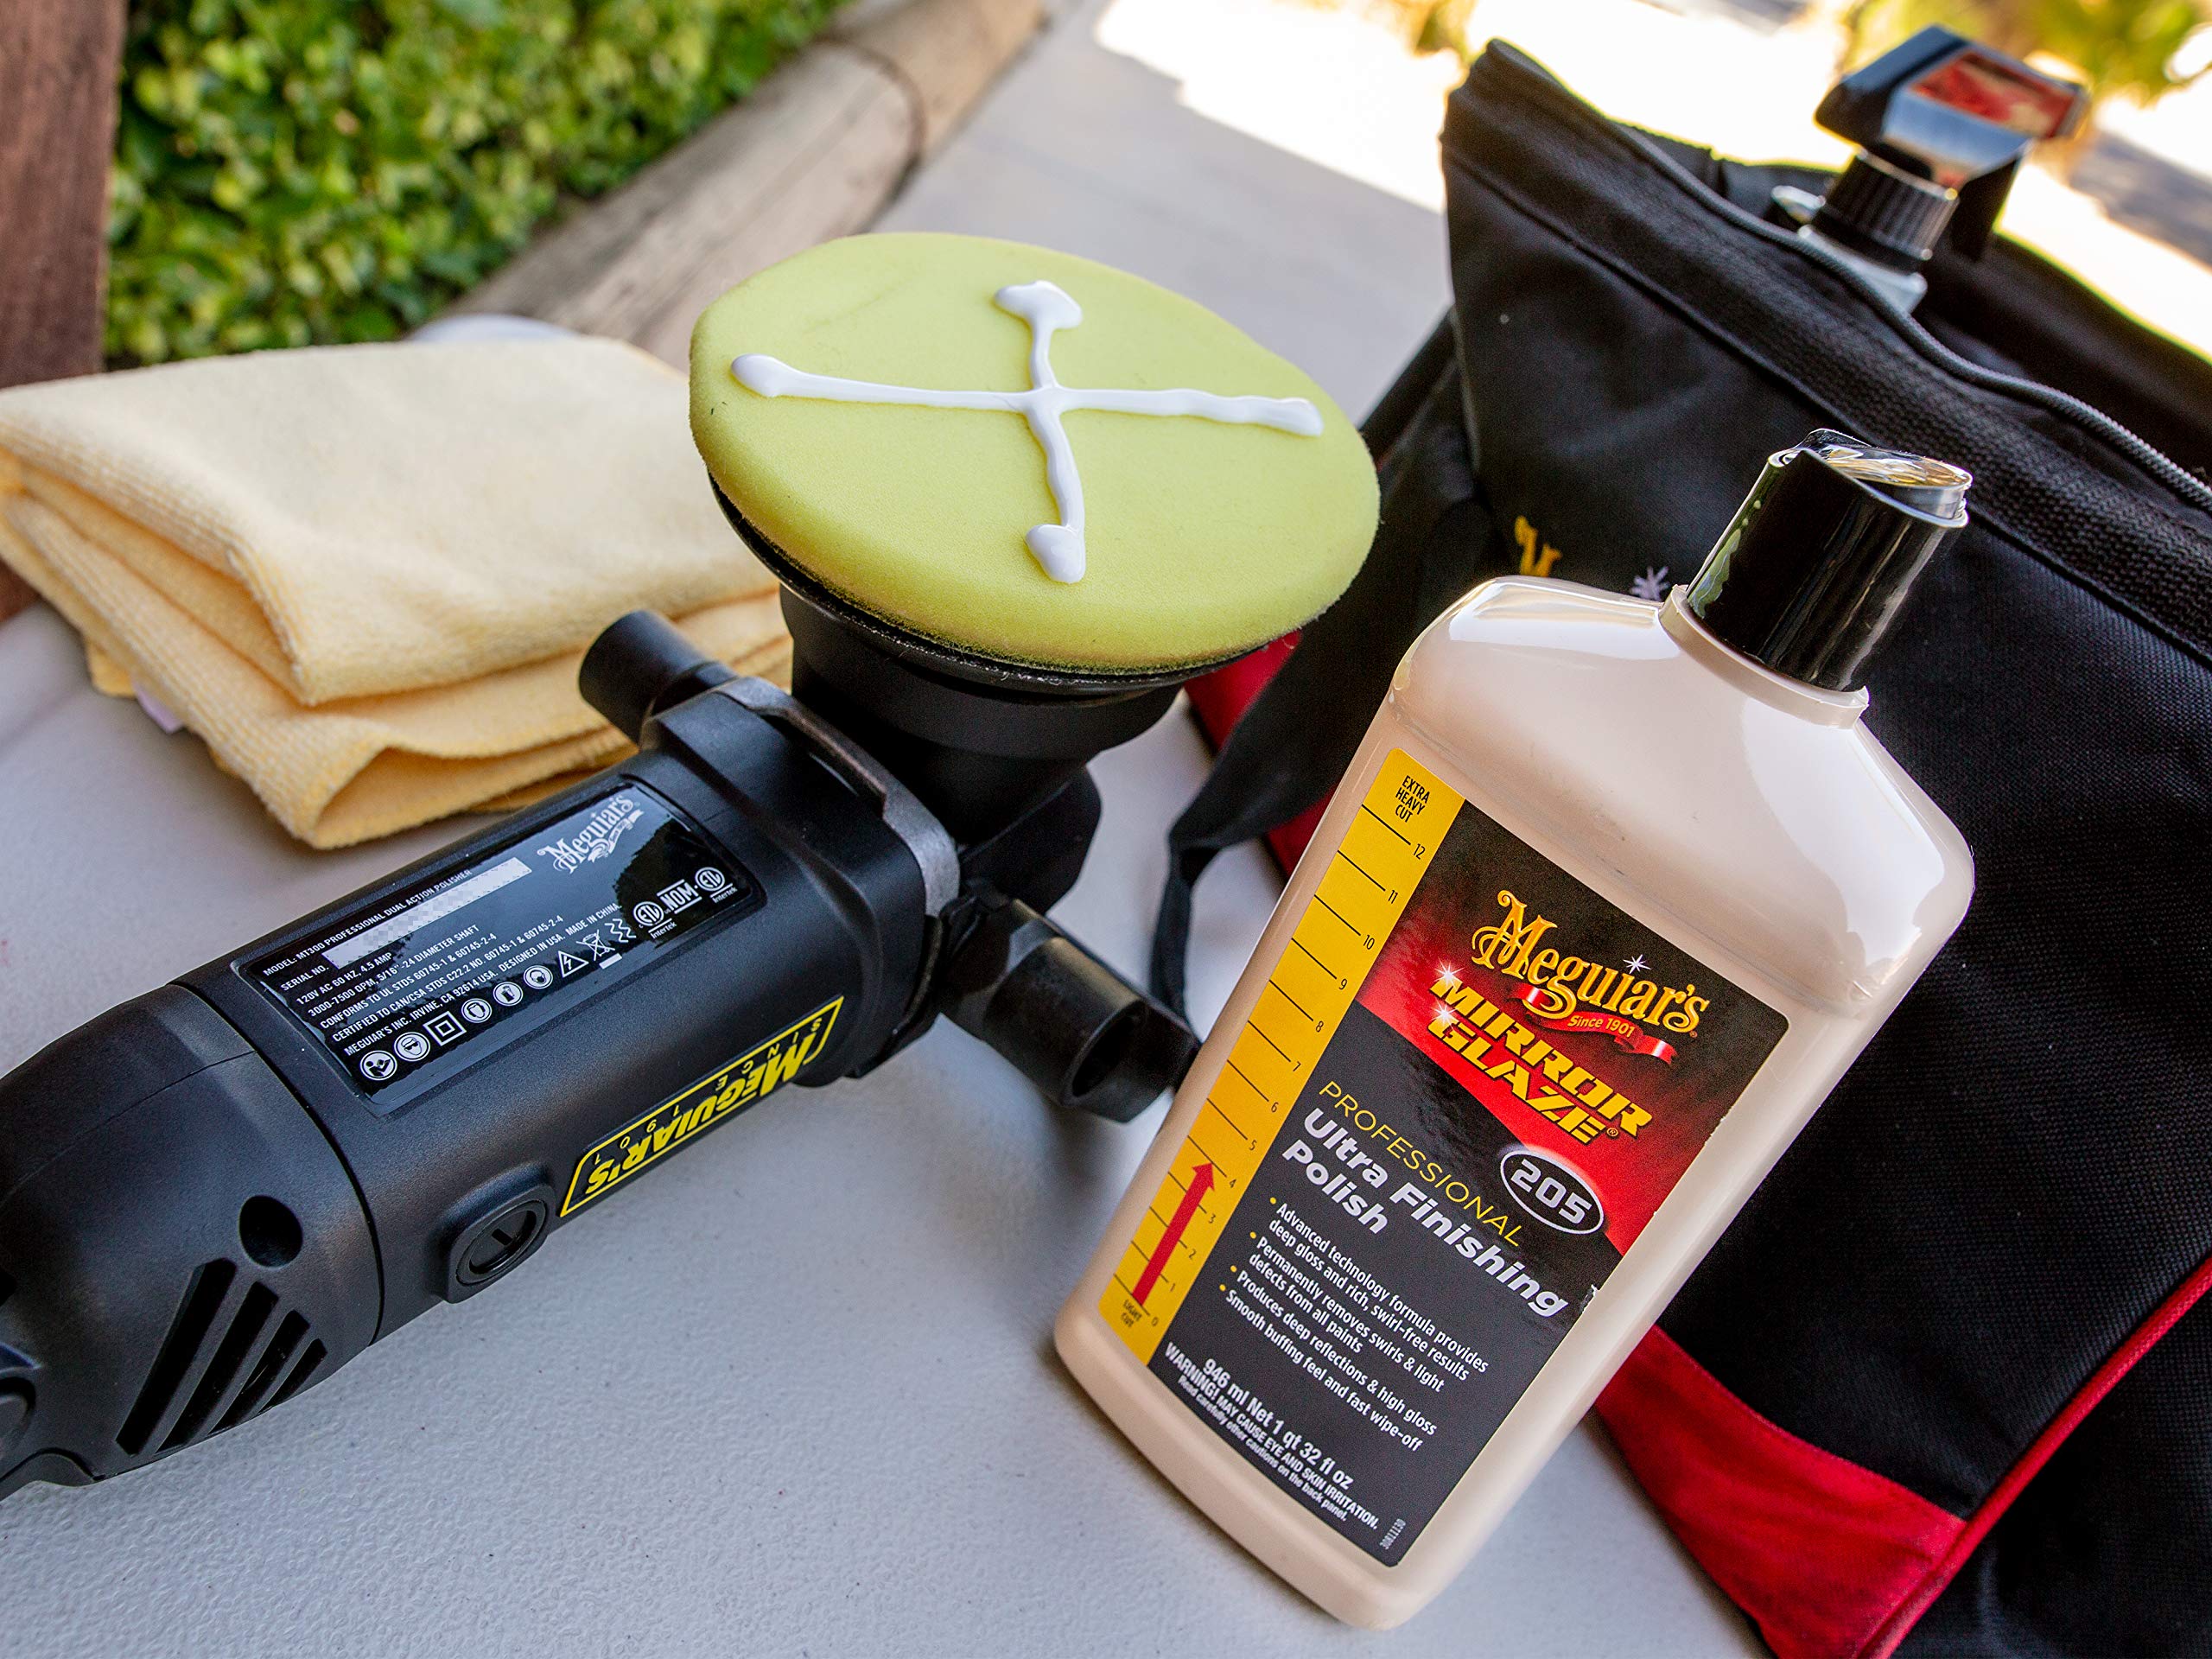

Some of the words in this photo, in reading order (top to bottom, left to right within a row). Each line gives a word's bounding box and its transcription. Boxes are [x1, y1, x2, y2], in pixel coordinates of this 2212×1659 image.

[1395, 786, 1426, 816] HEAVY
[1395, 804, 1414, 823] CUT
[1402, 774, 1431, 804] EXTRA
[537, 795, 634, 874] Meguiar's
[1413, 843, 1426, 861] 12
[263, 957, 298, 976] MODEL:
[296, 942, 326, 960] MT300
[323, 912, 386, 946] PROFESSIONAL
[383, 902, 408, 916] DUAL
[405, 887, 435, 906] ACTION
[433, 869, 474, 893] POLISHER
[660, 882, 699, 912] NOM
[711, 886, 738, 904] Intertek
[1388, 889, 1399, 905] 11
[650, 921, 677, 939] Intertek
[1363, 934, 1376, 950] 10
[1471, 890, 1710, 1033] Meguiar's
[280, 972, 314, 991] SERIAL
[311, 964, 329, 976] NO.
[296, 989, 320, 1005] 120V
[319, 983, 334, 994] AC
[332, 976, 346, 987] 60
[343, 969, 362, 981] HZ,
[360, 961, 375, 972] 4.5
[373, 952, 392, 966] AMP
[308, 988, 356, 1017] 3000-7500
[354, 978, 379, 993] OPM,
[376, 957, 416, 982] 5/16"-24
[413, 937, 456, 963] DIAMETER
[453, 924, 480, 942] SHAFT
[320, 1000, 370, 1029] CONFORMS
[366, 993, 382, 1004] TO
[378, 988, 394, 997] UL
[391, 976, 415, 991] STDS
[413, 958, 448, 980] 60745-1
[447, 954, 457, 963] &
[454, 932, 497, 958] 60745-2-4
[332, 1014, 378, 1042] CERTIFIED
[375, 1007, 391, 1018] TO
[389, 988, 427, 1012] CAN/CSA
[425, 976, 448, 993] STDS
[446, 964, 472, 982] C22.2
[468, 957, 486, 969] NO.
[484, 939, 518, 961] 60745-1
[523, 914, 563, 940] 60745-2-4
[344, 1026, 393, 1056] MEGUIAR'S
[391, 1016, 412, 1031] INC.
[410, 1000, 443, 1020] IRVINE,
[440, 992, 455, 1004] CA
[452, 978, 480, 997] 92614
[477, 969, 499, 983] USA.
[498, 947, 538, 972] DESIGNED
[536, 941, 549, 951] IN
[545, 933, 566, 946] USA.
[565, 919, 588, 936] MADE
[586, 914, 598, 925] IN
[594, 902, 622, 919] CHINA.
[1338, 978, 1348, 990] 9
[716, 1018, 823, 1090] SINCE
[1315, 1020, 1325, 1033] 8
[1429, 974, 1652, 1137] MIRROR
[1567, 1015, 1604, 1028] Since
[1605, 1018, 1635, 1037] 1901
[1293, 1060, 1301, 1072] 7
[585, 1033, 817, 1194] MEGUIAR'S
[594, 1105, 680, 1166] 1901
[1270, 1101, 1279, 1113] 6
[1248, 1139, 1258, 1151] 5
[1319, 1080, 1522, 1247] PROFESSIONAL
[1229, 1179, 1237, 1189] 4
[1281, 1139, 1388, 1234] Polish
[1304, 1107, 1389, 1189] Ultra
[1389, 1181, 1569, 1317] Finishing
[1510, 1158, 1592, 1224] 205
[1208, 1213, 1217, 1224] 3
[1188, 1248, 1198, 1260] 2
[1170, 1282, 1177, 1293] 1
[1249, 1254, 1287, 1291] defects
[1285, 1284, 1313, 1313] from
[1312, 1308, 1331, 1325] all
[1325, 1320, 1363, 1353] paints
[1256, 1236, 1324, 1300] Permanently
[1321, 1294, 1371, 1338] removes
[1368, 1332, 1405, 1363] swirls
[1402, 1357, 1415, 1372] &
[1414, 1363, 1445, 1393] light
[1268, 1219, 1297, 1248] deep
[1294, 1243, 1325, 1272] gloss
[1323, 1266, 1349, 1289] and
[1344, 1284, 1369, 1312] rich,
[1370, 1305, 1428, 1353] swirl-free
[1427, 1346, 1470, 1381] results
[1275, 1203, 1331, 1253] Advanced
[1327, 1245, 1391, 1302] technology
[1388, 1294, 1436, 1337] formula
[1433, 1331, 1490, 1373] provides
[1152, 1317, 1158, 1326] 0
[1236, 1269, 1284, 1318] Produces
[1282, 1313, 1312, 1340] deep
[1309, 1335, 1369, 1386] reflections
[1366, 1379, 1379, 1395] &
[1376, 1386, 1406, 1414] high
[1402, 1408, 1438, 1436] gloss
[1225, 1289, 1266, 1331] Smooth
[1263, 1323, 1305, 1364] buffing
[1302, 1357, 1328, 1381] feel
[1324, 1376, 1350, 1399] and
[1346, 1391, 1371, 1416] fast
[1370, 1410, 1424, 1452] wipe-off
[1165, 1341, 1221, 1401] WARNING!
[1216, 1395, 1240, 1418] MAY
[1236, 1413, 1268, 1443] CAUSE
[1263, 1436, 1285, 1458] EYE
[1281, 1452, 1304, 1472] AND
[1301, 1467, 1327, 1491] SKIN
[1324, 1484, 1379, 1529] IRRITATION.
[1177, 1374, 1199, 1397] Read
[1195, 1393, 1229, 1426] carefully
[1225, 1421, 1248, 1441] other
[1245, 1438, 1280, 1469] cautions
[1277, 1464, 1291, 1478] on
[1287, 1471, 1304, 1488] the
[1301, 1482, 1324, 1503] back
[1320, 1498, 1348, 1522] panel.
[1203, 1358, 1231, 1389] 946
[1227, 1382, 1250, 1406] ml
[1245, 1396, 1274, 1427] Net
[1272, 1420, 1285, 1435] 1
[1282, 1431, 1303, 1451] qt
[1299, 1441, 1322, 1465] 32
[1319, 1457, 1336, 1476] fl
[1332, 1470, 1354, 1491] oz
